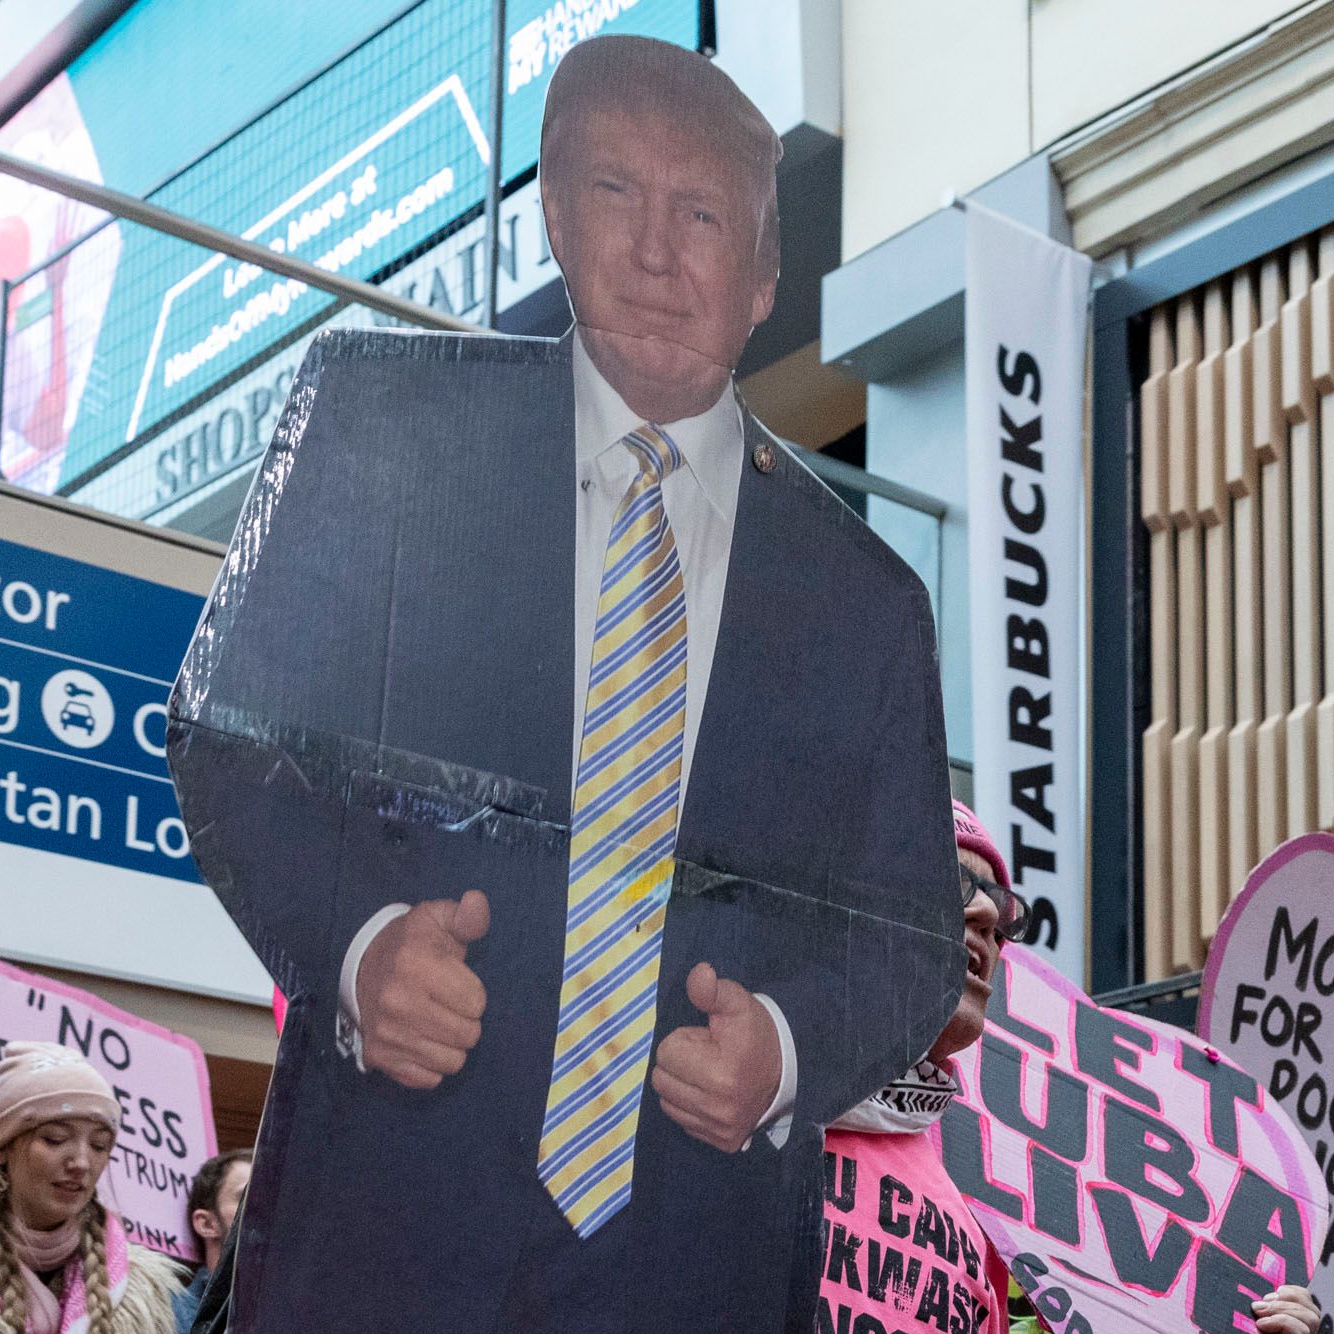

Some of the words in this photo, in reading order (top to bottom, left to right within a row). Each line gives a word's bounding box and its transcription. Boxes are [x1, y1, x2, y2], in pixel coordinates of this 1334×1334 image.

[997, 343, 1060, 952] STARBUCKS
[126, 795, 190, 859] Lo
[984, 957, 1264, 1161] LET
[1230, 983, 1323, 1064] FOR
[954, 1034, 1311, 1288] UBA
[122, 1215, 181, 1254] PINK
